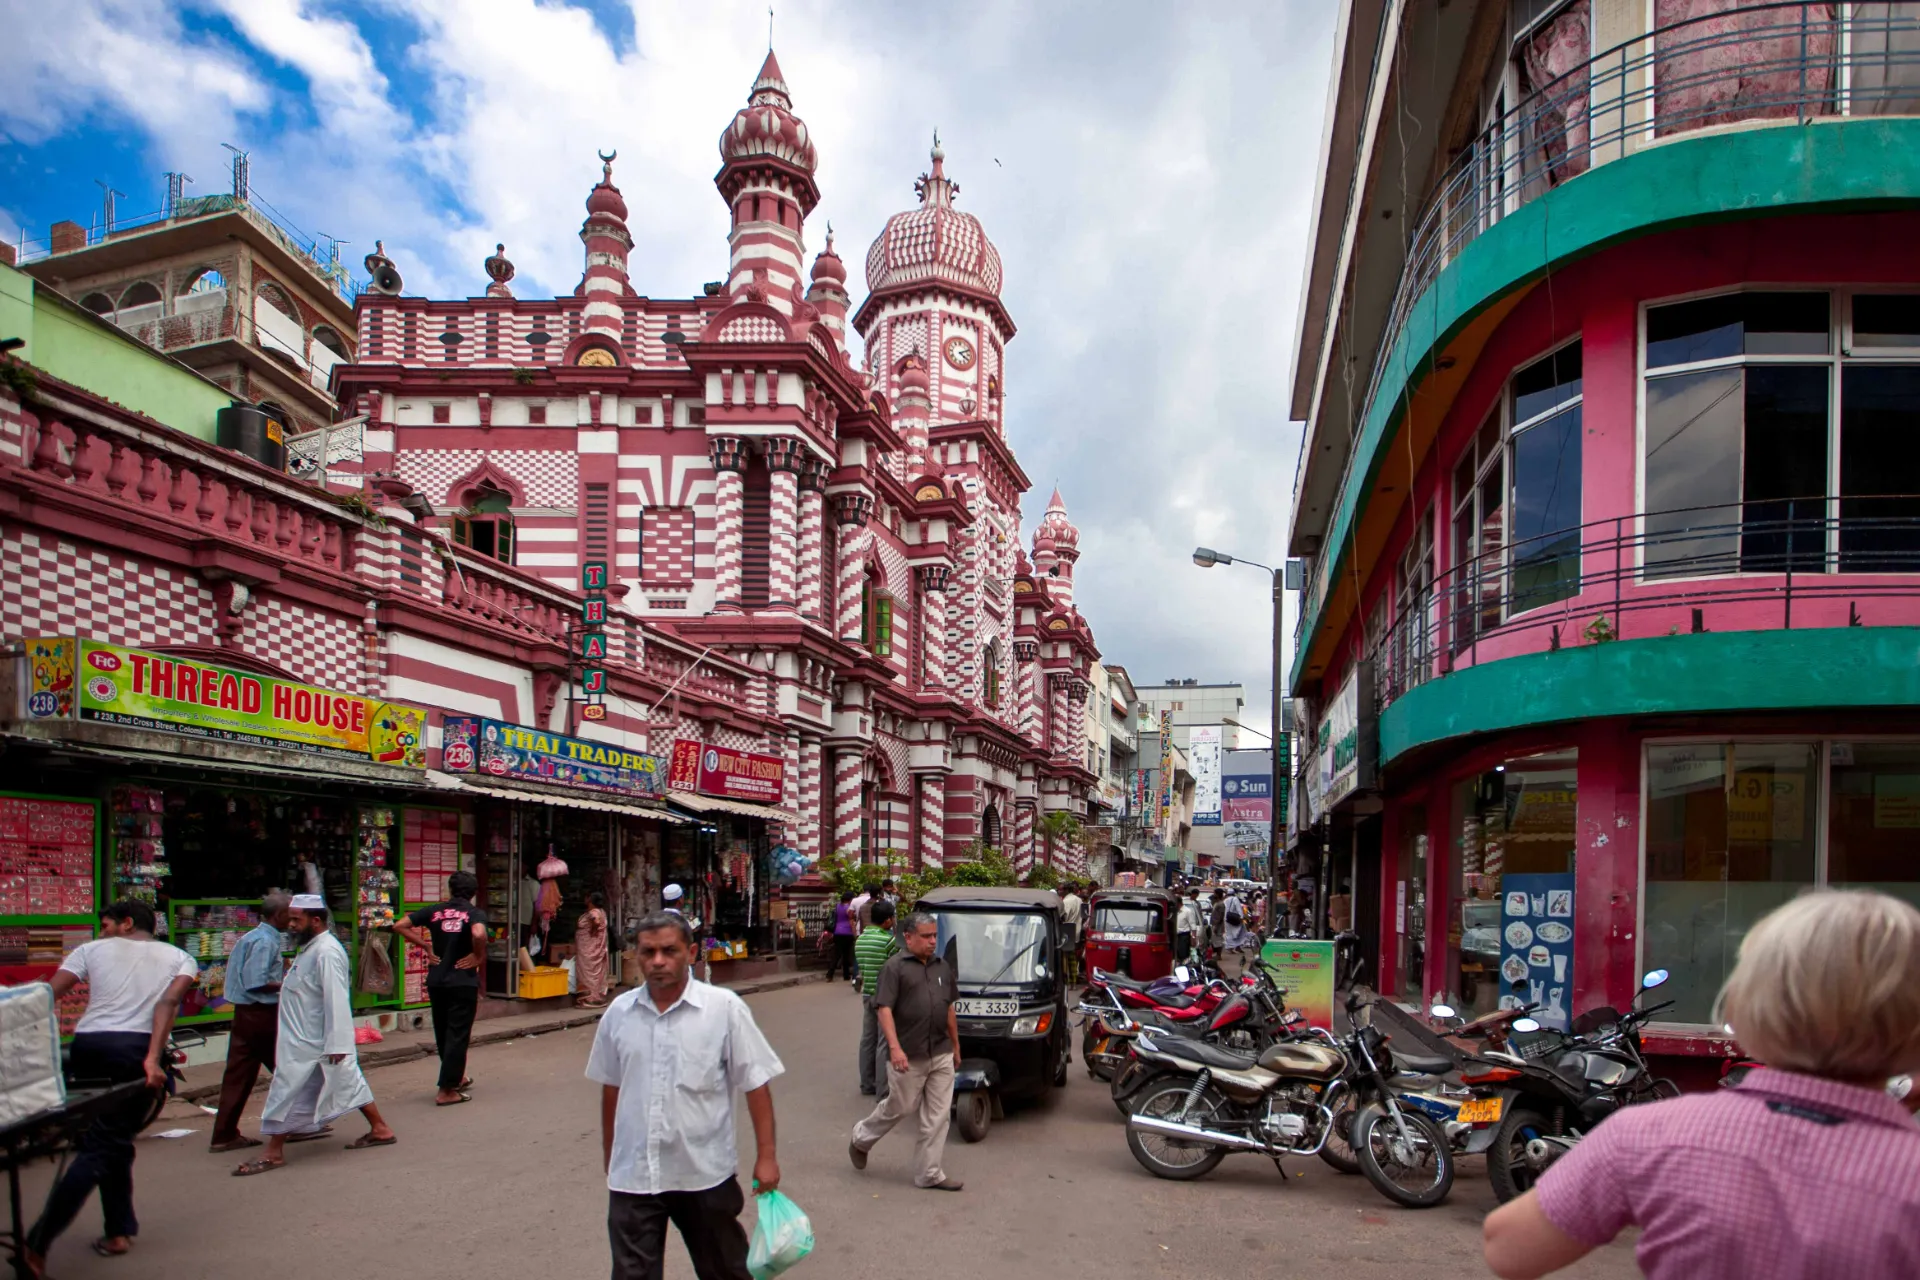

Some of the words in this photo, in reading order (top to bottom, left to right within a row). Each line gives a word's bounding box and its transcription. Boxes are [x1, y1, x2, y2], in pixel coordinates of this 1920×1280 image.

[586, 566, 603, 691] THAJ
[129, 654, 262, 714] THREAD
[273, 683, 365, 734] HOUSE
[32, 695, 54, 712] 238
[586, 707, 601, 717] 236
[118, 715, 132, 725] 2nd
[133, 717, 154, 728] Cross
[155, 721, 177, 732] Street,
[179, 724, 208, 736] Colombo
[223, 731, 232, 739] Tel
[263, 738, 274, 746] Fax
[152, 705, 191, 719] Importers
[202, 713, 239, 727] Wholesale
[242, 720, 269, 731] Dealers
[279, 727, 312, 739] Garments
[1161, 712, 1170, 758] FASHION
[448, 747, 471, 763] 236
[501, 728, 559, 755] THAJ
[565, 741, 657, 773] TRADERS
[490, 762, 505, 771] 236
[674, 751, 685, 781] CITY
[718, 753, 735, 773] NEW
[735, 757, 751, 776] CITY
[752, 760, 782, 780] FASHION
[523, 774, 546, 782] Cross
[547, 777, 570, 786] Street,
[571, 781, 601, 790] Colombo
[674, 781, 691, 790] 234
[1240, 779, 1267, 793] Sun
[1232, 807, 1263, 818] Astra
[954, 1001, 971, 1013] QX
[985, 1002, 1018, 1014] 3339
